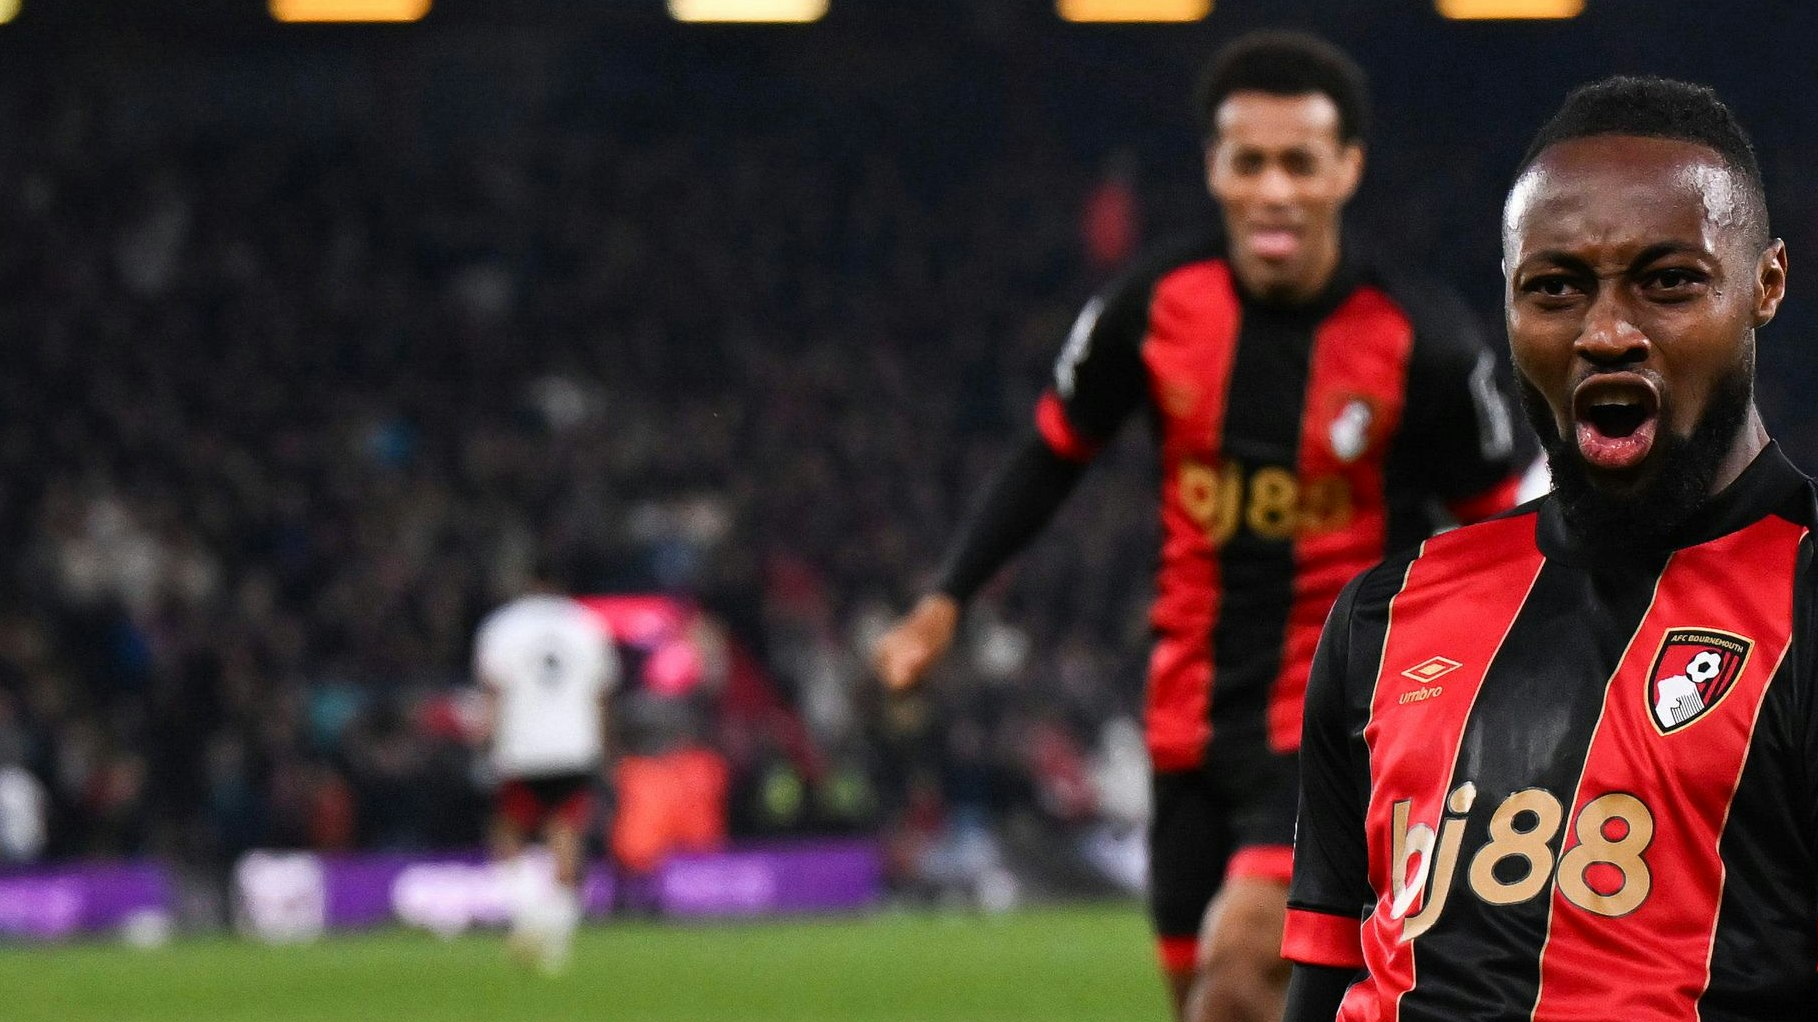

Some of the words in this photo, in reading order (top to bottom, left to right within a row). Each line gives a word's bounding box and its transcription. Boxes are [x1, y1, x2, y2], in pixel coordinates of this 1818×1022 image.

[1688, 635, 1744, 653] BOURNEMOUTH
[1399, 686, 1443, 705] umbro
[1390, 780, 1655, 944] bj88
